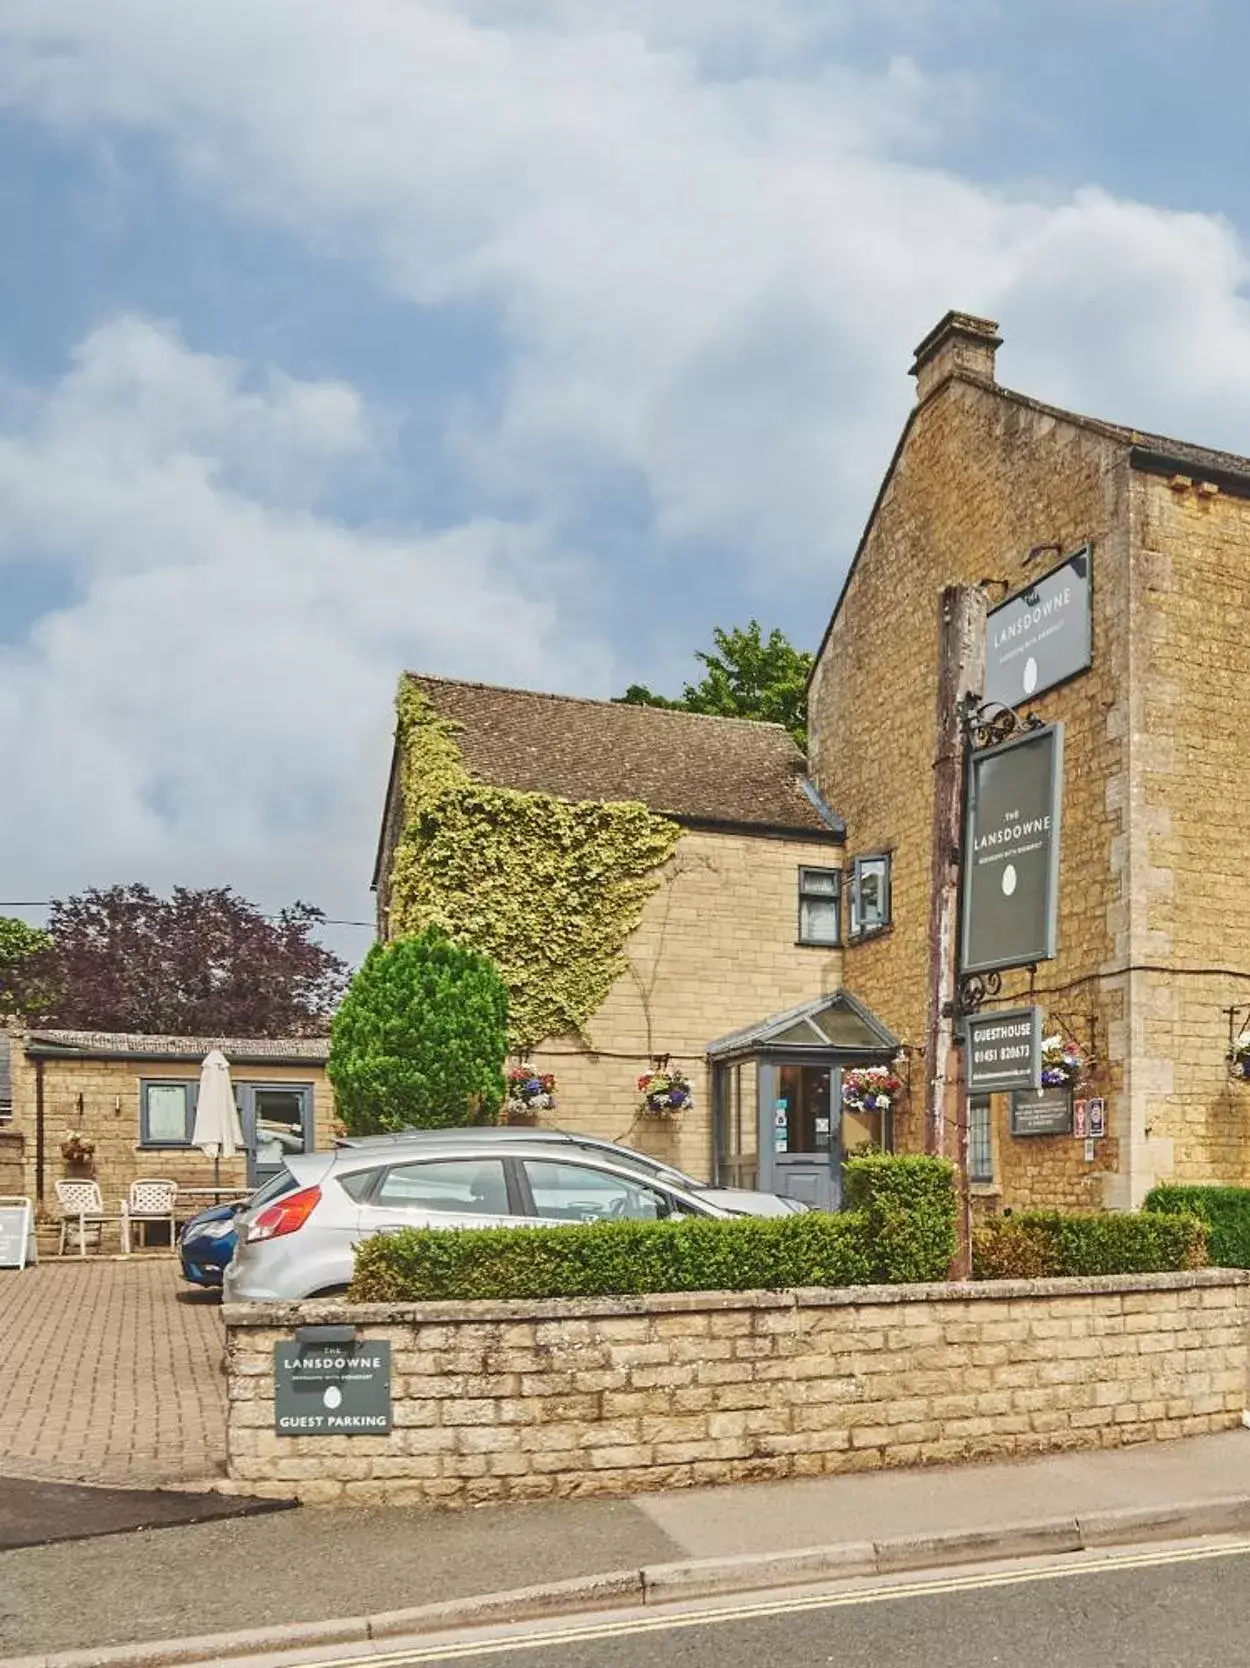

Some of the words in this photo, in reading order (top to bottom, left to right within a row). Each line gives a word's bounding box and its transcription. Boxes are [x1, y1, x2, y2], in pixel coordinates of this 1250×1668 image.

[994, 587, 1071, 649] LANSDOWNE
[1005, 810, 1020, 821] THE
[974, 816, 1051, 851] LANSDOWNE
[974, 1022, 1031, 1043] GUESTHOUSE
[284, 1357, 381, 1369] LANSDOWNE
[280, 1415, 324, 1428] GUEST
[327, 1415, 387, 1428] PARKING
